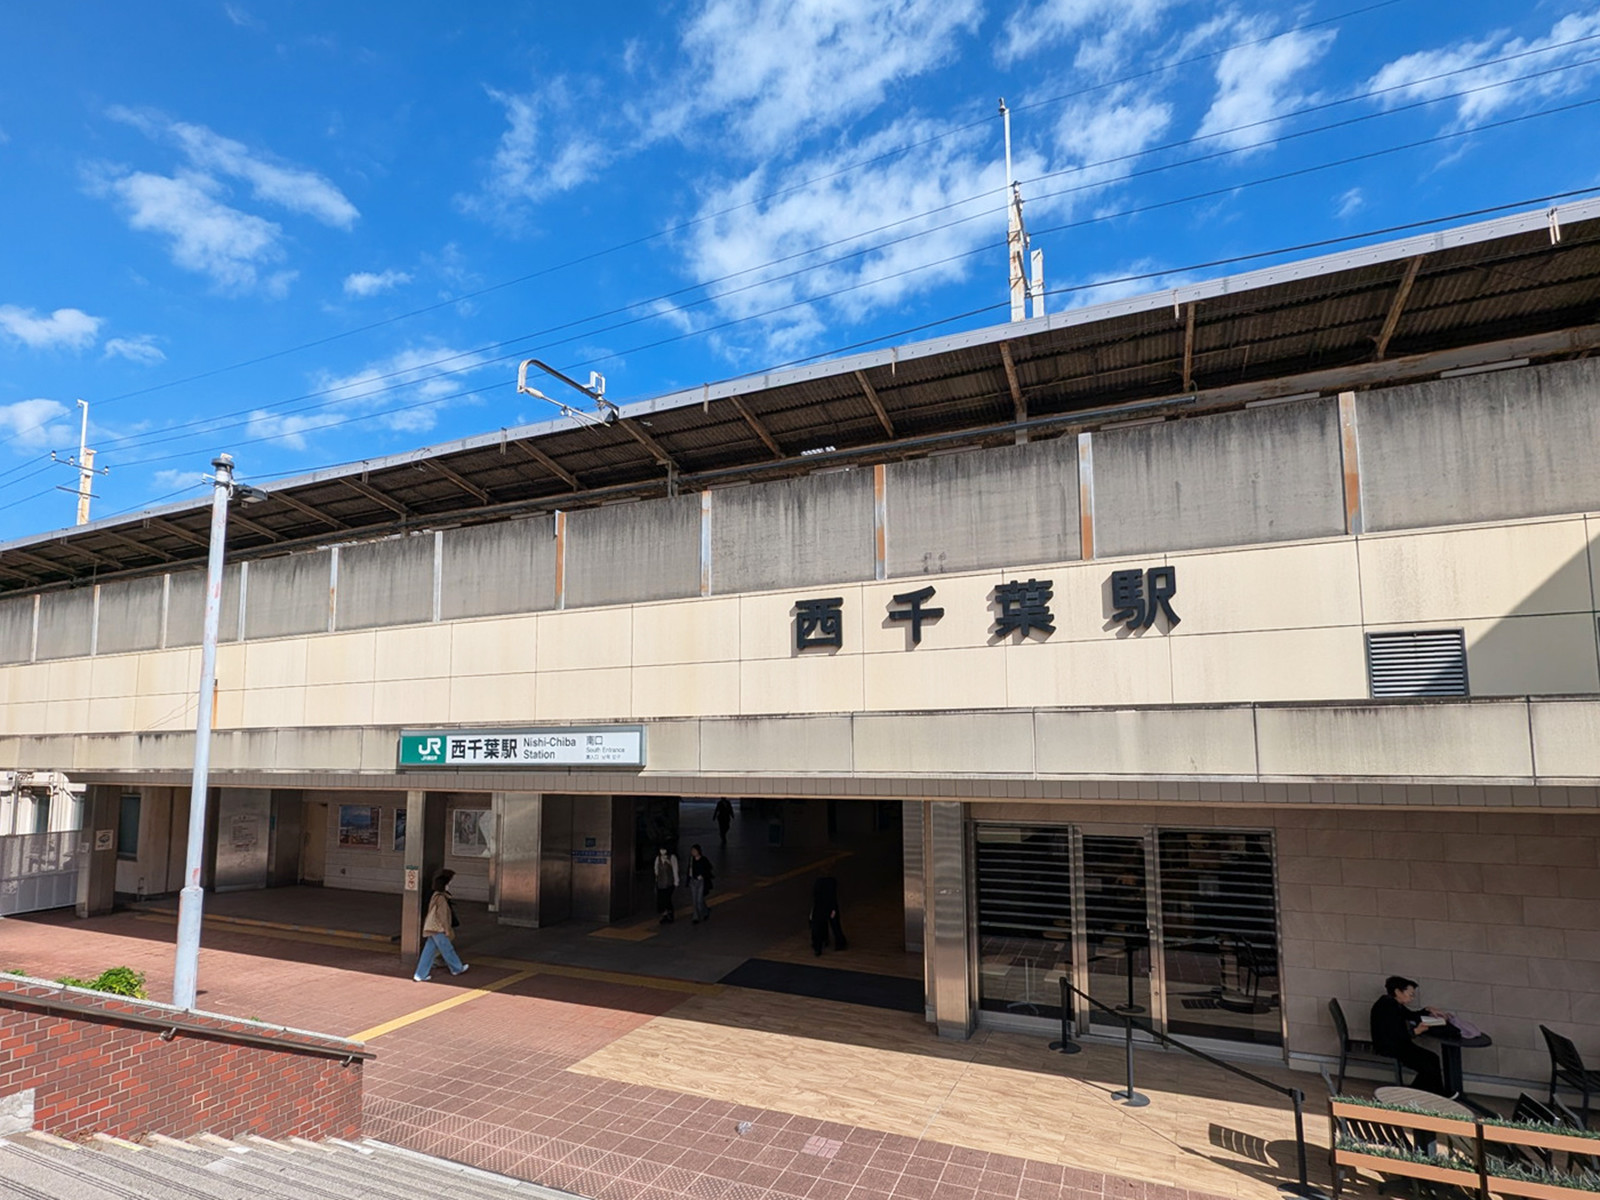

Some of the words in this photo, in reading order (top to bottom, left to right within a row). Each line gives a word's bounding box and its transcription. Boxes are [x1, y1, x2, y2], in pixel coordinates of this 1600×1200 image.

[795, 565, 1181, 649] 西千葉駅
[418, 737, 442, 755] JR
[451, 738, 518, 759] 西千葉駅
[523, 737, 577, 748] Nishi-Chiba
[523, 749, 556, 760] Station
